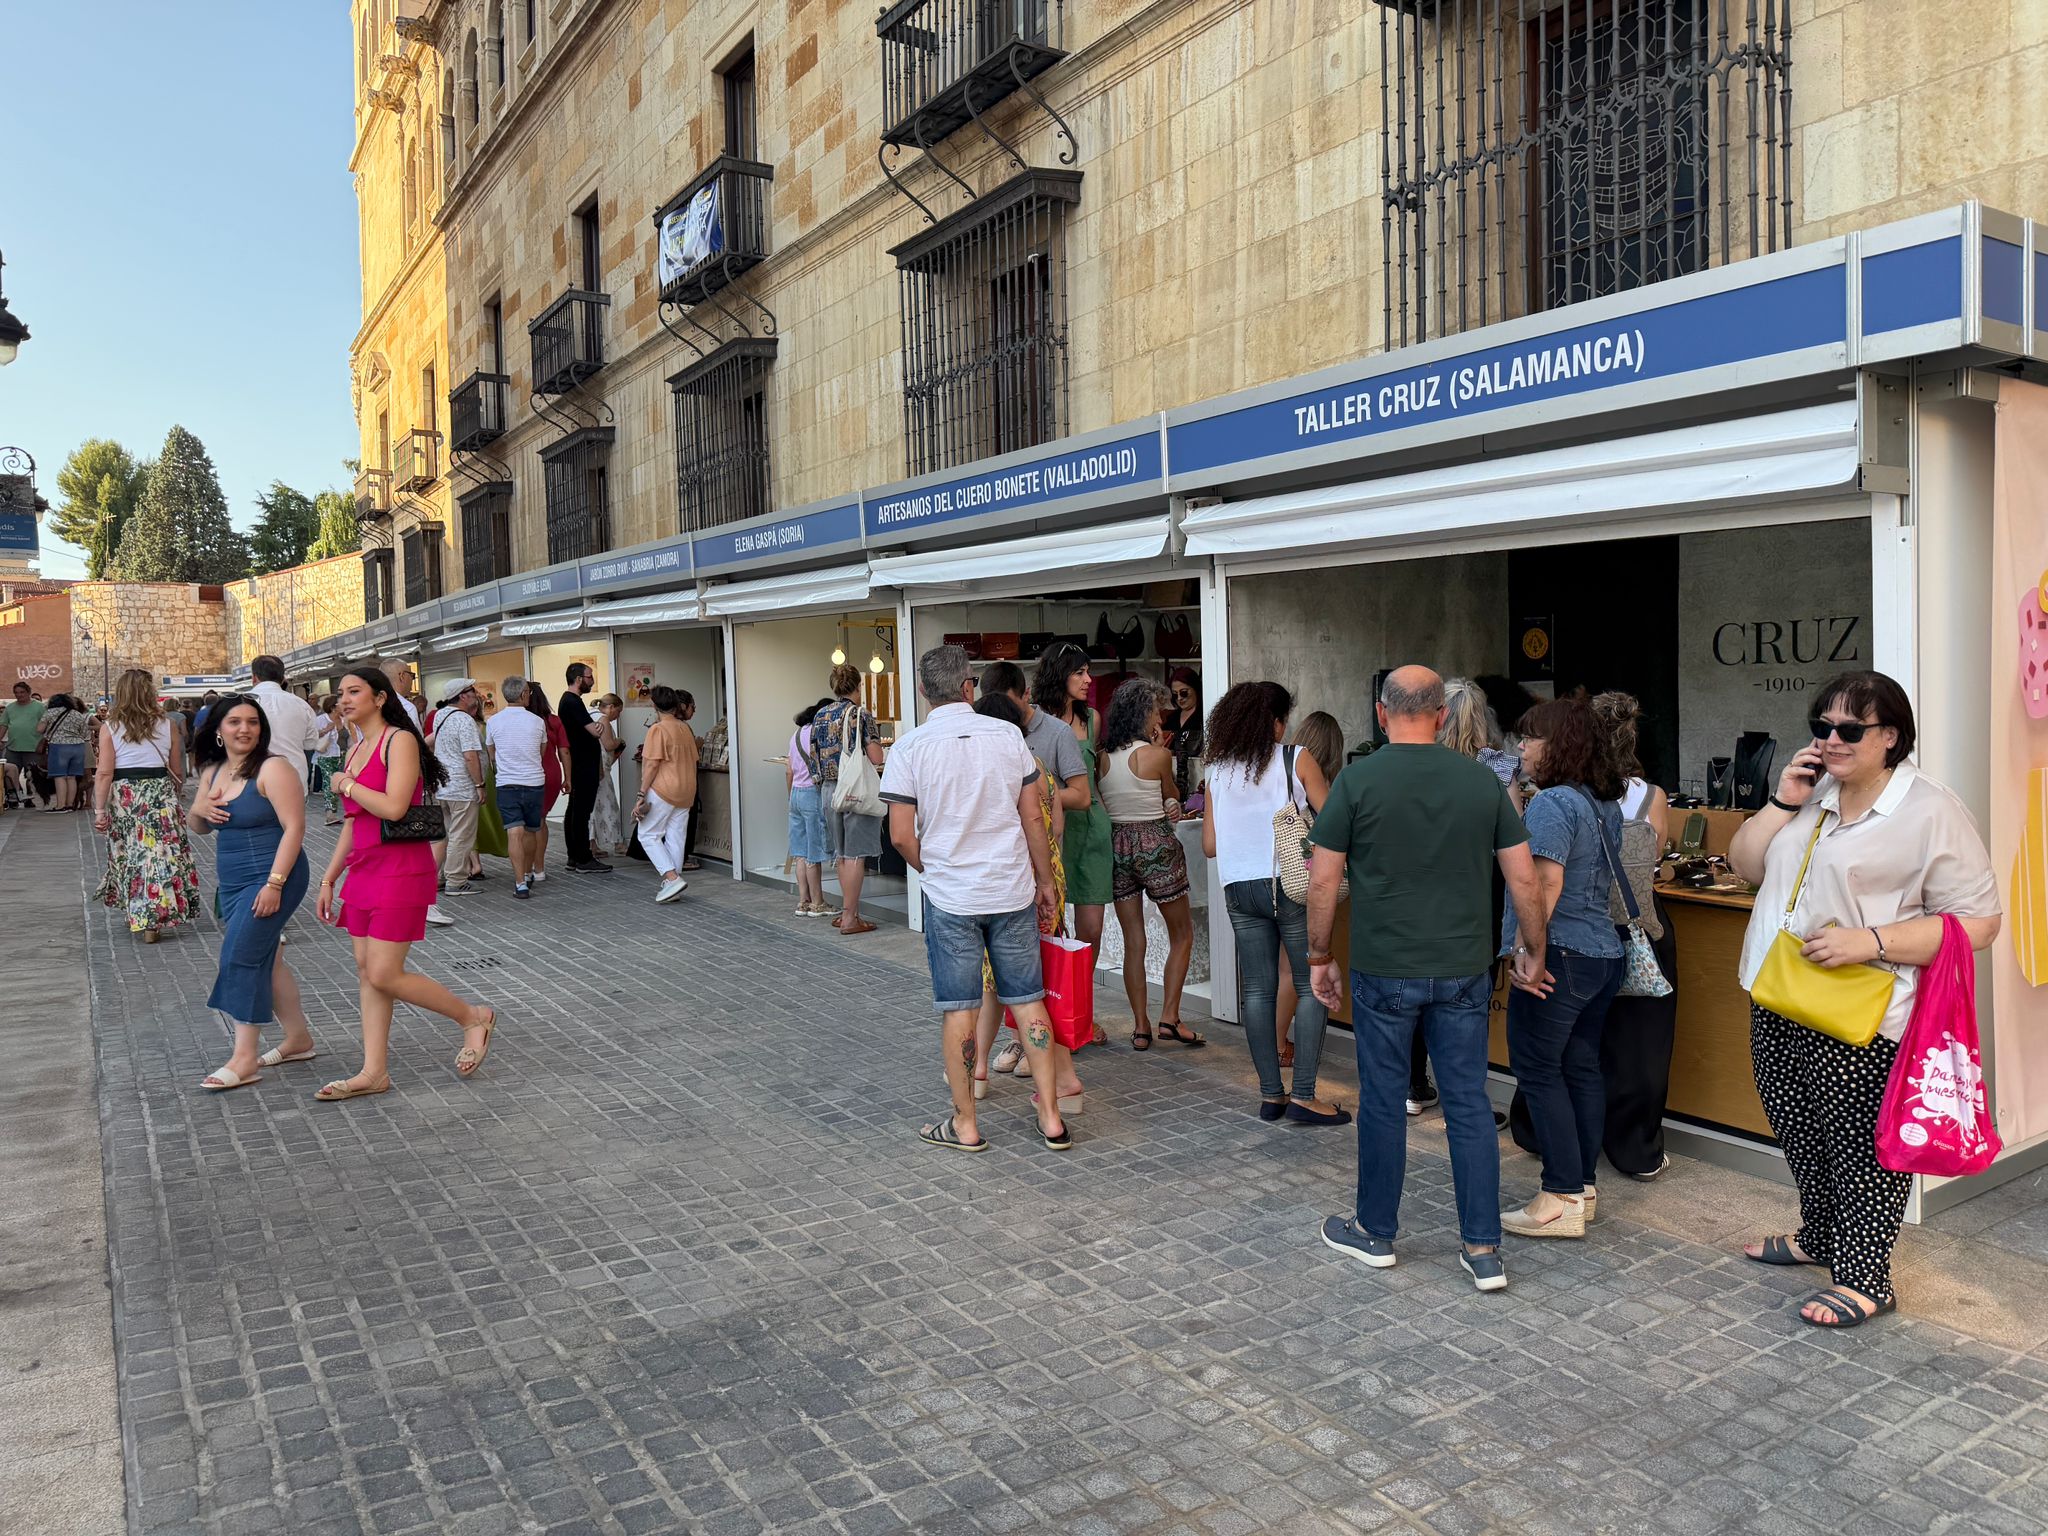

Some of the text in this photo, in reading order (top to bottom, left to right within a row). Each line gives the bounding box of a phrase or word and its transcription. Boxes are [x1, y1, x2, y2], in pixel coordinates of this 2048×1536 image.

[1294, 329, 1645, 435] TALLER CRUZ (SALAMANCA)
[878, 447, 1137, 524] ARTESANOS DEL CUERO BONETE (VALLADOLID)
[655, 551, 680, 571] (ZAMORA)
[735, 524, 804, 553] ELENA GASPÁ (SORIA)
[1712, 616, 1859, 666] CRUZ
